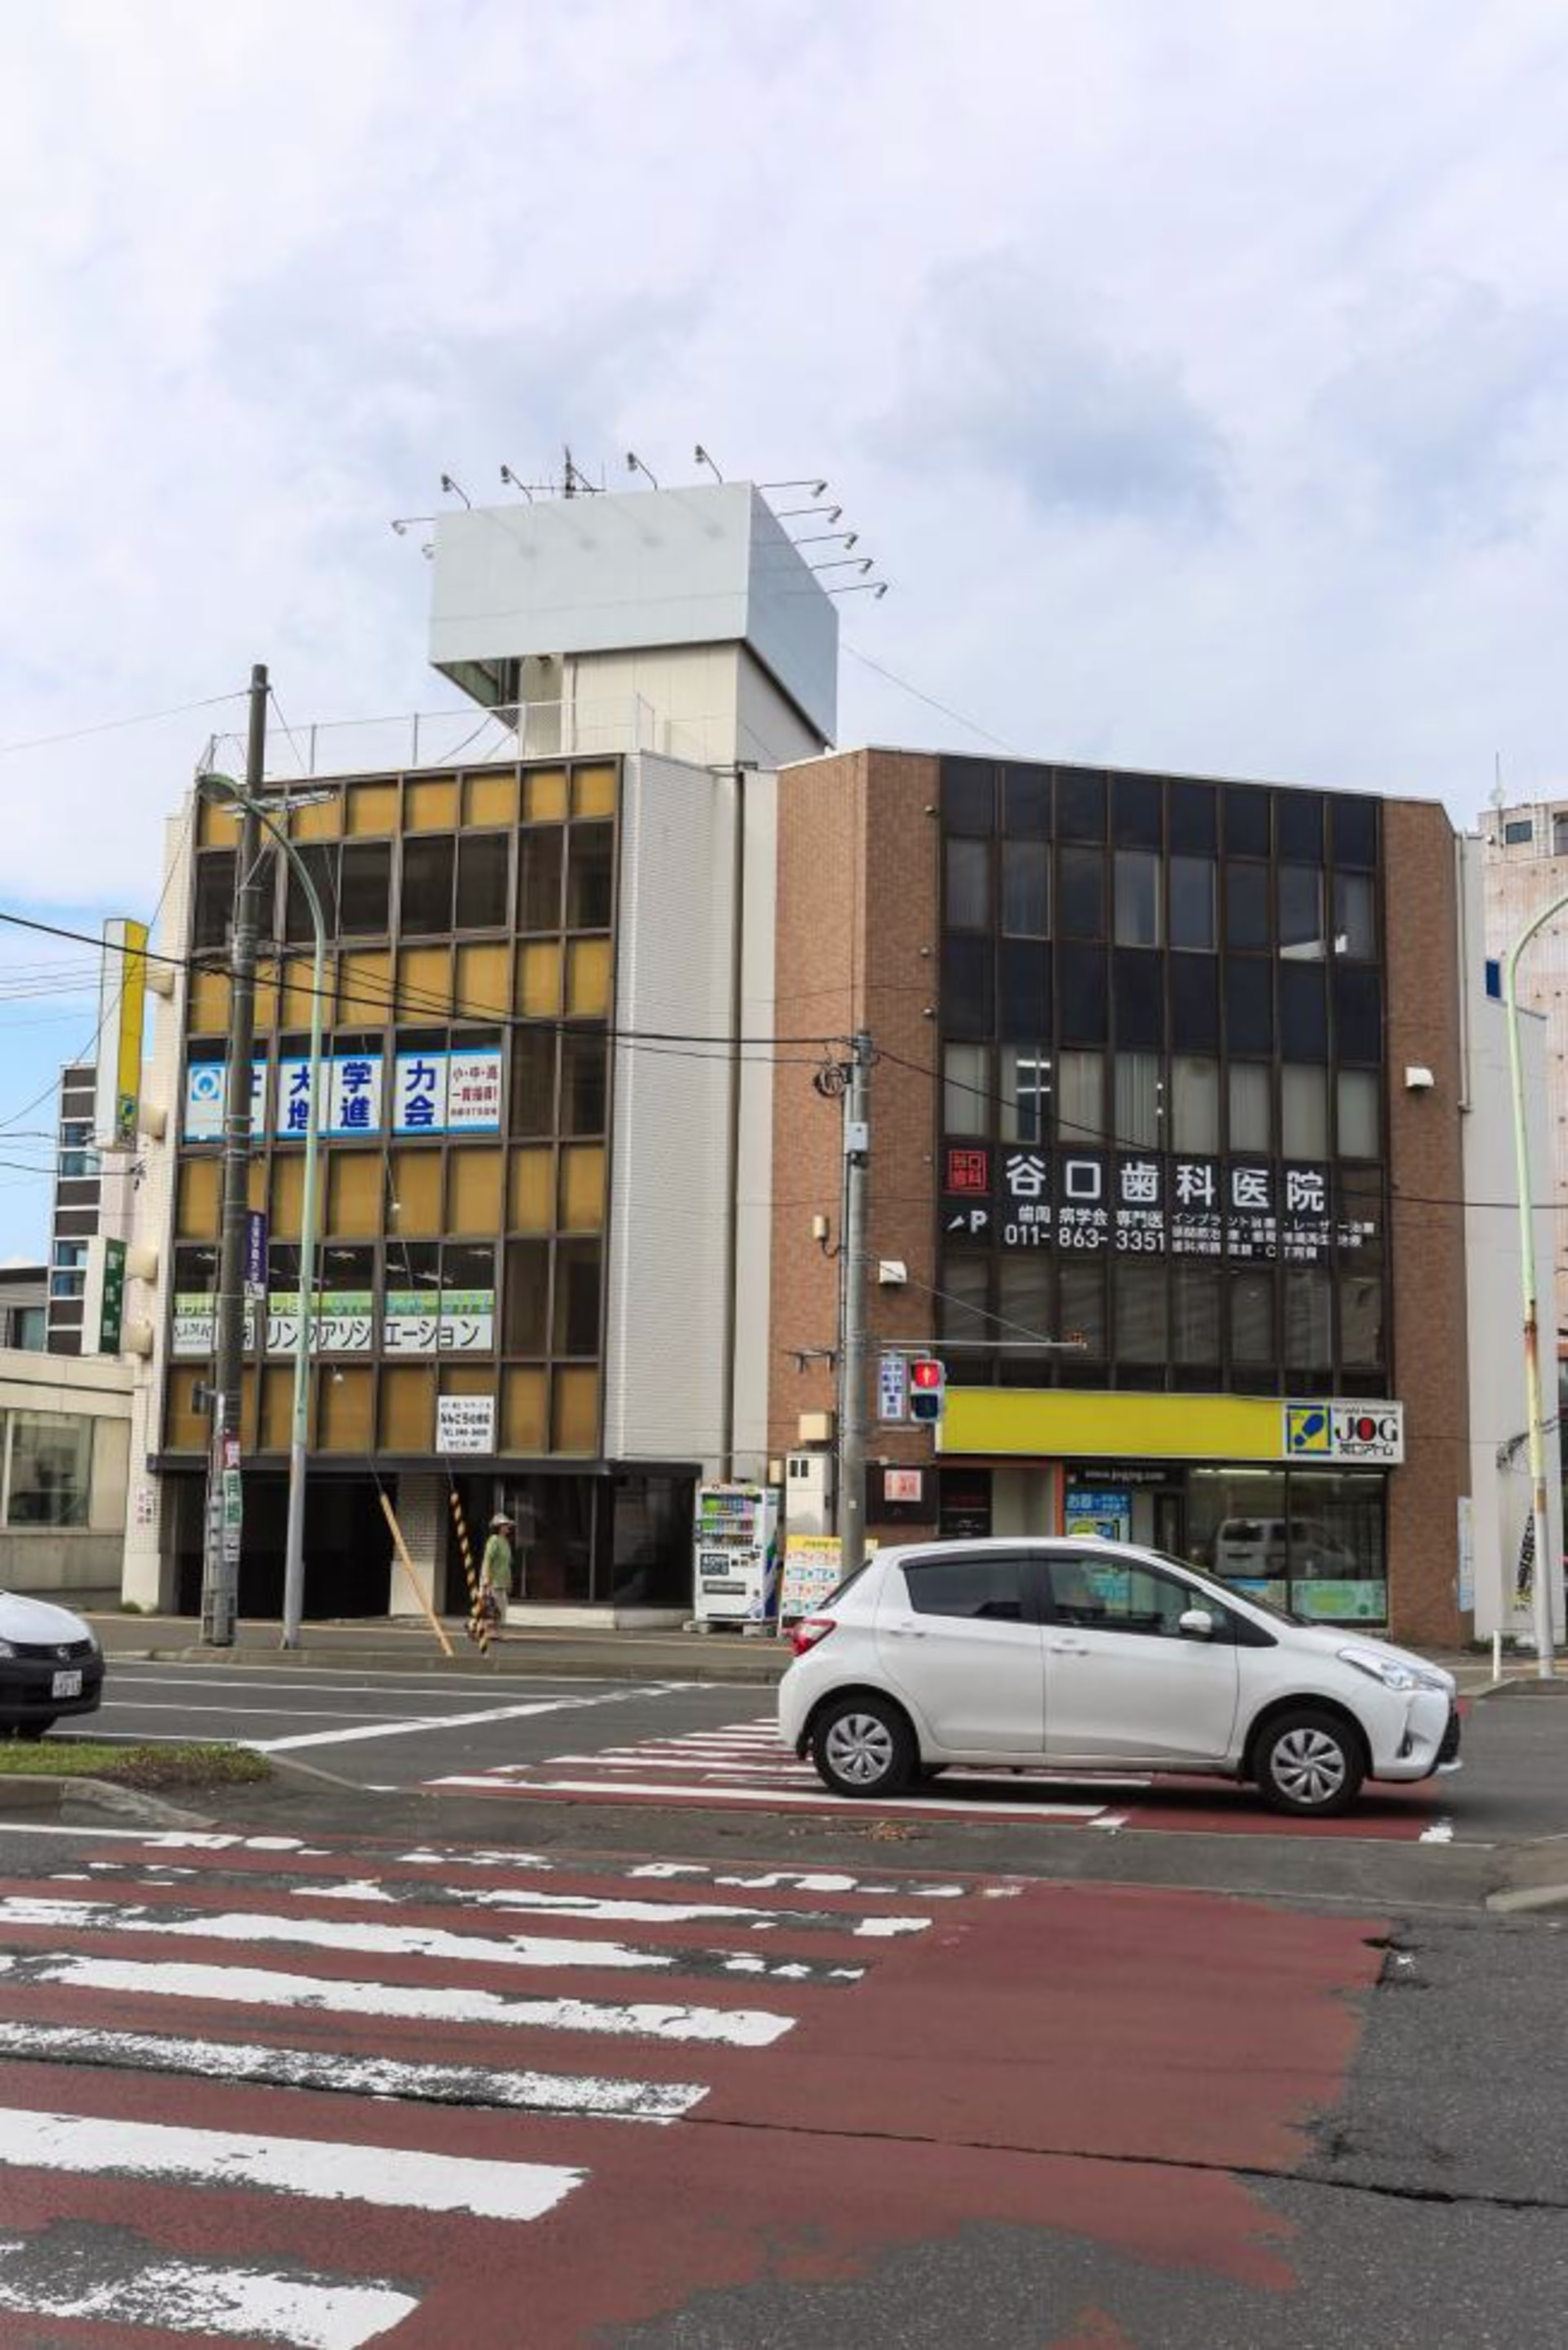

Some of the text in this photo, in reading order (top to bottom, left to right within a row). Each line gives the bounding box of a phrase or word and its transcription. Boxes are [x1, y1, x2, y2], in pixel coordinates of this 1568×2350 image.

[1006, 1154, 1325, 1212] 谷口歯科医院
[970, 1210, 987, 1233] P
[1005, 1224, 1165, 1251] 011-863-3351
[1334, 1416, 1397, 1442] JOG
